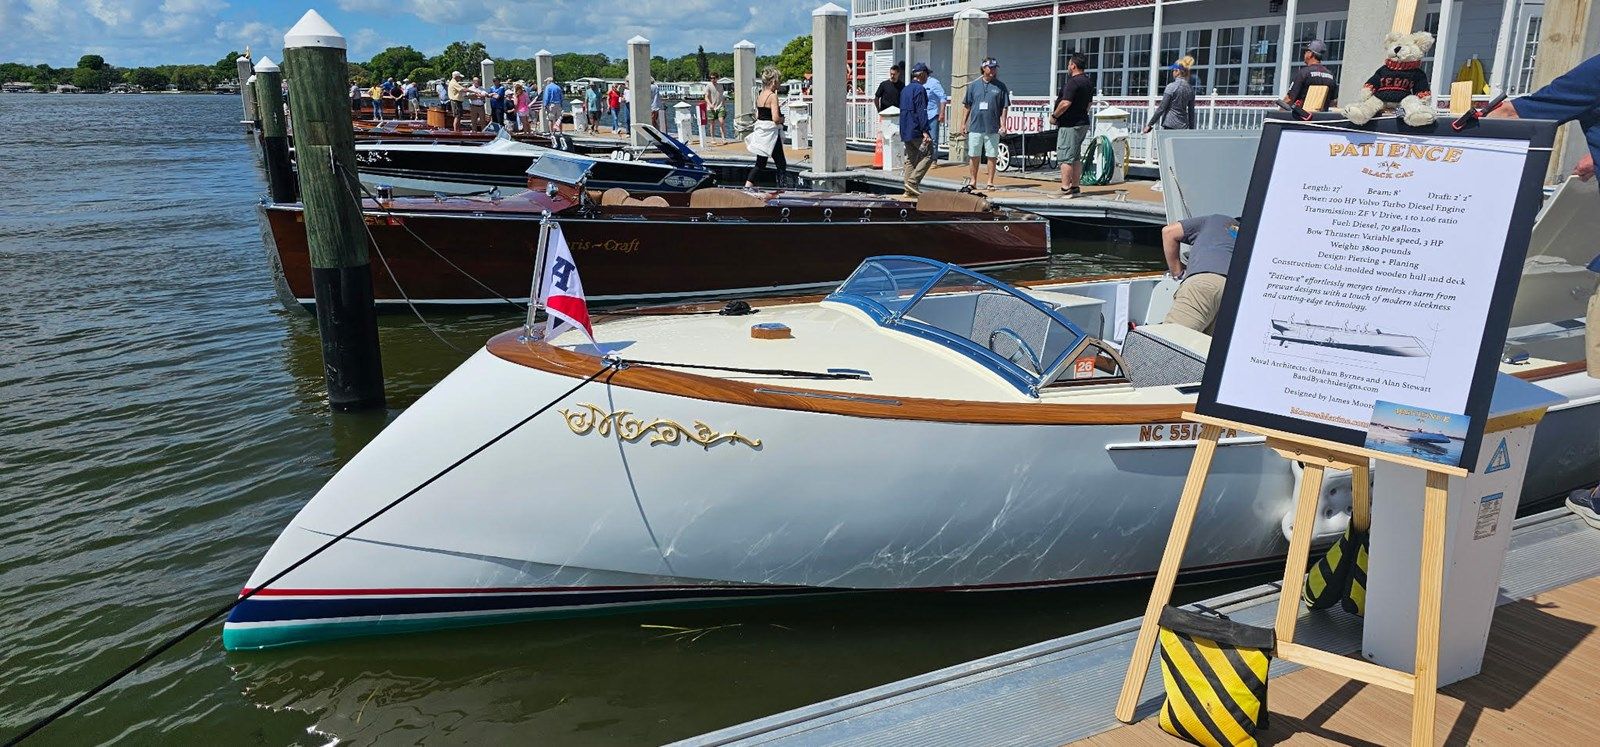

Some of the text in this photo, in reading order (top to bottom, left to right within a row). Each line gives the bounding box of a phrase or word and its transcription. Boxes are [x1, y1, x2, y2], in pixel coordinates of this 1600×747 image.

[1329, 143, 1464, 164] PATIENCE
[1362, 167, 1392, 179] BLACK
[1302, 183, 1330, 191] Length:
[1366, 187, 1391, 195] Beam:
[1302, 193, 1327, 202] Power:
[1382, 200, 1406, 208] Turbo
[1407, 202, 1434, 210] Diesel
[1435, 204, 1465, 214] Engine
[1304, 205, 1356, 215] Transmission:
[1378, 211, 1402, 220] Drive,
[1352, 220, 1378, 230] Diesel,
[1390, 224, 1420, 232] gallons
[1324, 229, 1360, 238] Thruster:
[1362, 232, 1394, 242] Variable
[1396, 237, 1421, 245] speed,
[1330, 240, 1359, 250] Weight:
[569, 239, 640, 253] ris-Craft
[1317, 250, 1346, 261] Design:
[1348, 254, 1379, 265] Piercing
[1388, 258, 1419, 270] Planing
[552, 256, 575, 292] A
[1271, 257, 1322, 268] Construction:
[1323, 263, 1374, 274] Cold-molded
[1376, 270, 1407, 279] wooden
[1409, 272, 1426, 281] hull
[1445, 276, 1465, 285] deck
[1304, 276, 1345, 288] effortlessly
[1346, 283, 1373, 291] merges
[1374, 284, 1405, 294] timeless
[1407, 288, 1434, 298] charm
[1434, 292, 1456, 300] from
[1277, 294, 1323, 306] cutting-edge
[1324, 299, 1366, 312] technology.
[1294, 284, 1321, 295] designs
[1348, 292, 1370, 300] touch
[1371, 294, 1382, 303] of
[1381, 297, 1411, 306] modern
[1413, 300, 1450, 310] sleekness
[1077, 361, 1093, 372] 26
[1250, 356, 1269, 365] Naval
[1270, 360, 1307, 371] Architects:
[1308, 366, 1337, 376] Graham
[1339, 371, 1364, 381] Byrnes
[1381, 379, 1400, 387] Alan
[1401, 381, 1431, 392] Stewart
[1284, 386, 1316, 398] Designed
[1318, 392, 1327, 401] by
[1328, 395, 1349, 404] James
[1140, 425, 1164, 441] NC
